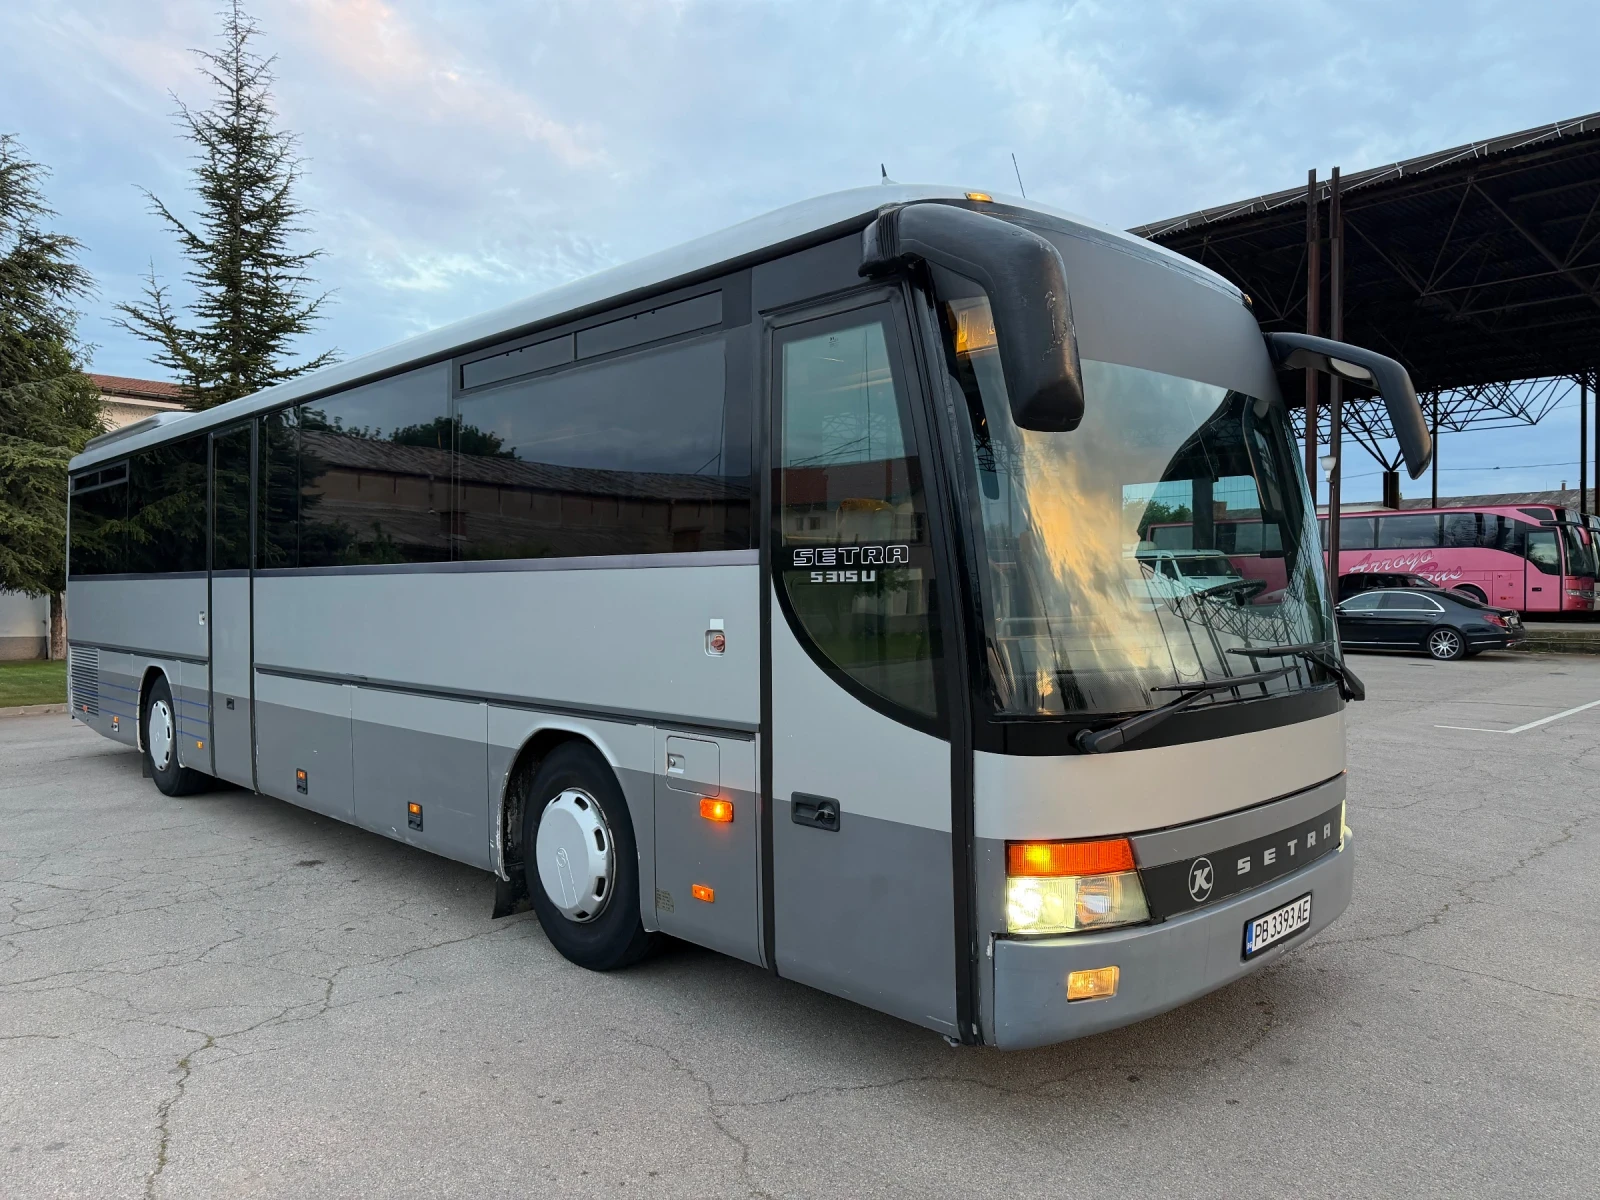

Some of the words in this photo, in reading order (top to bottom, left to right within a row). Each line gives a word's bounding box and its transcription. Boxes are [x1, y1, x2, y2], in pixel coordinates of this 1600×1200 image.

[793, 545, 909, 566] SETRA
[1349, 550, 1434, 573] Arroyo
[1414, 562, 1464, 582] Bus
[1237, 822, 1331, 875] SETRA
[1254, 920, 1269, 947] PB
[1270, 907, 1295, 938] 3393
[1296, 899, 1309, 926] AE
